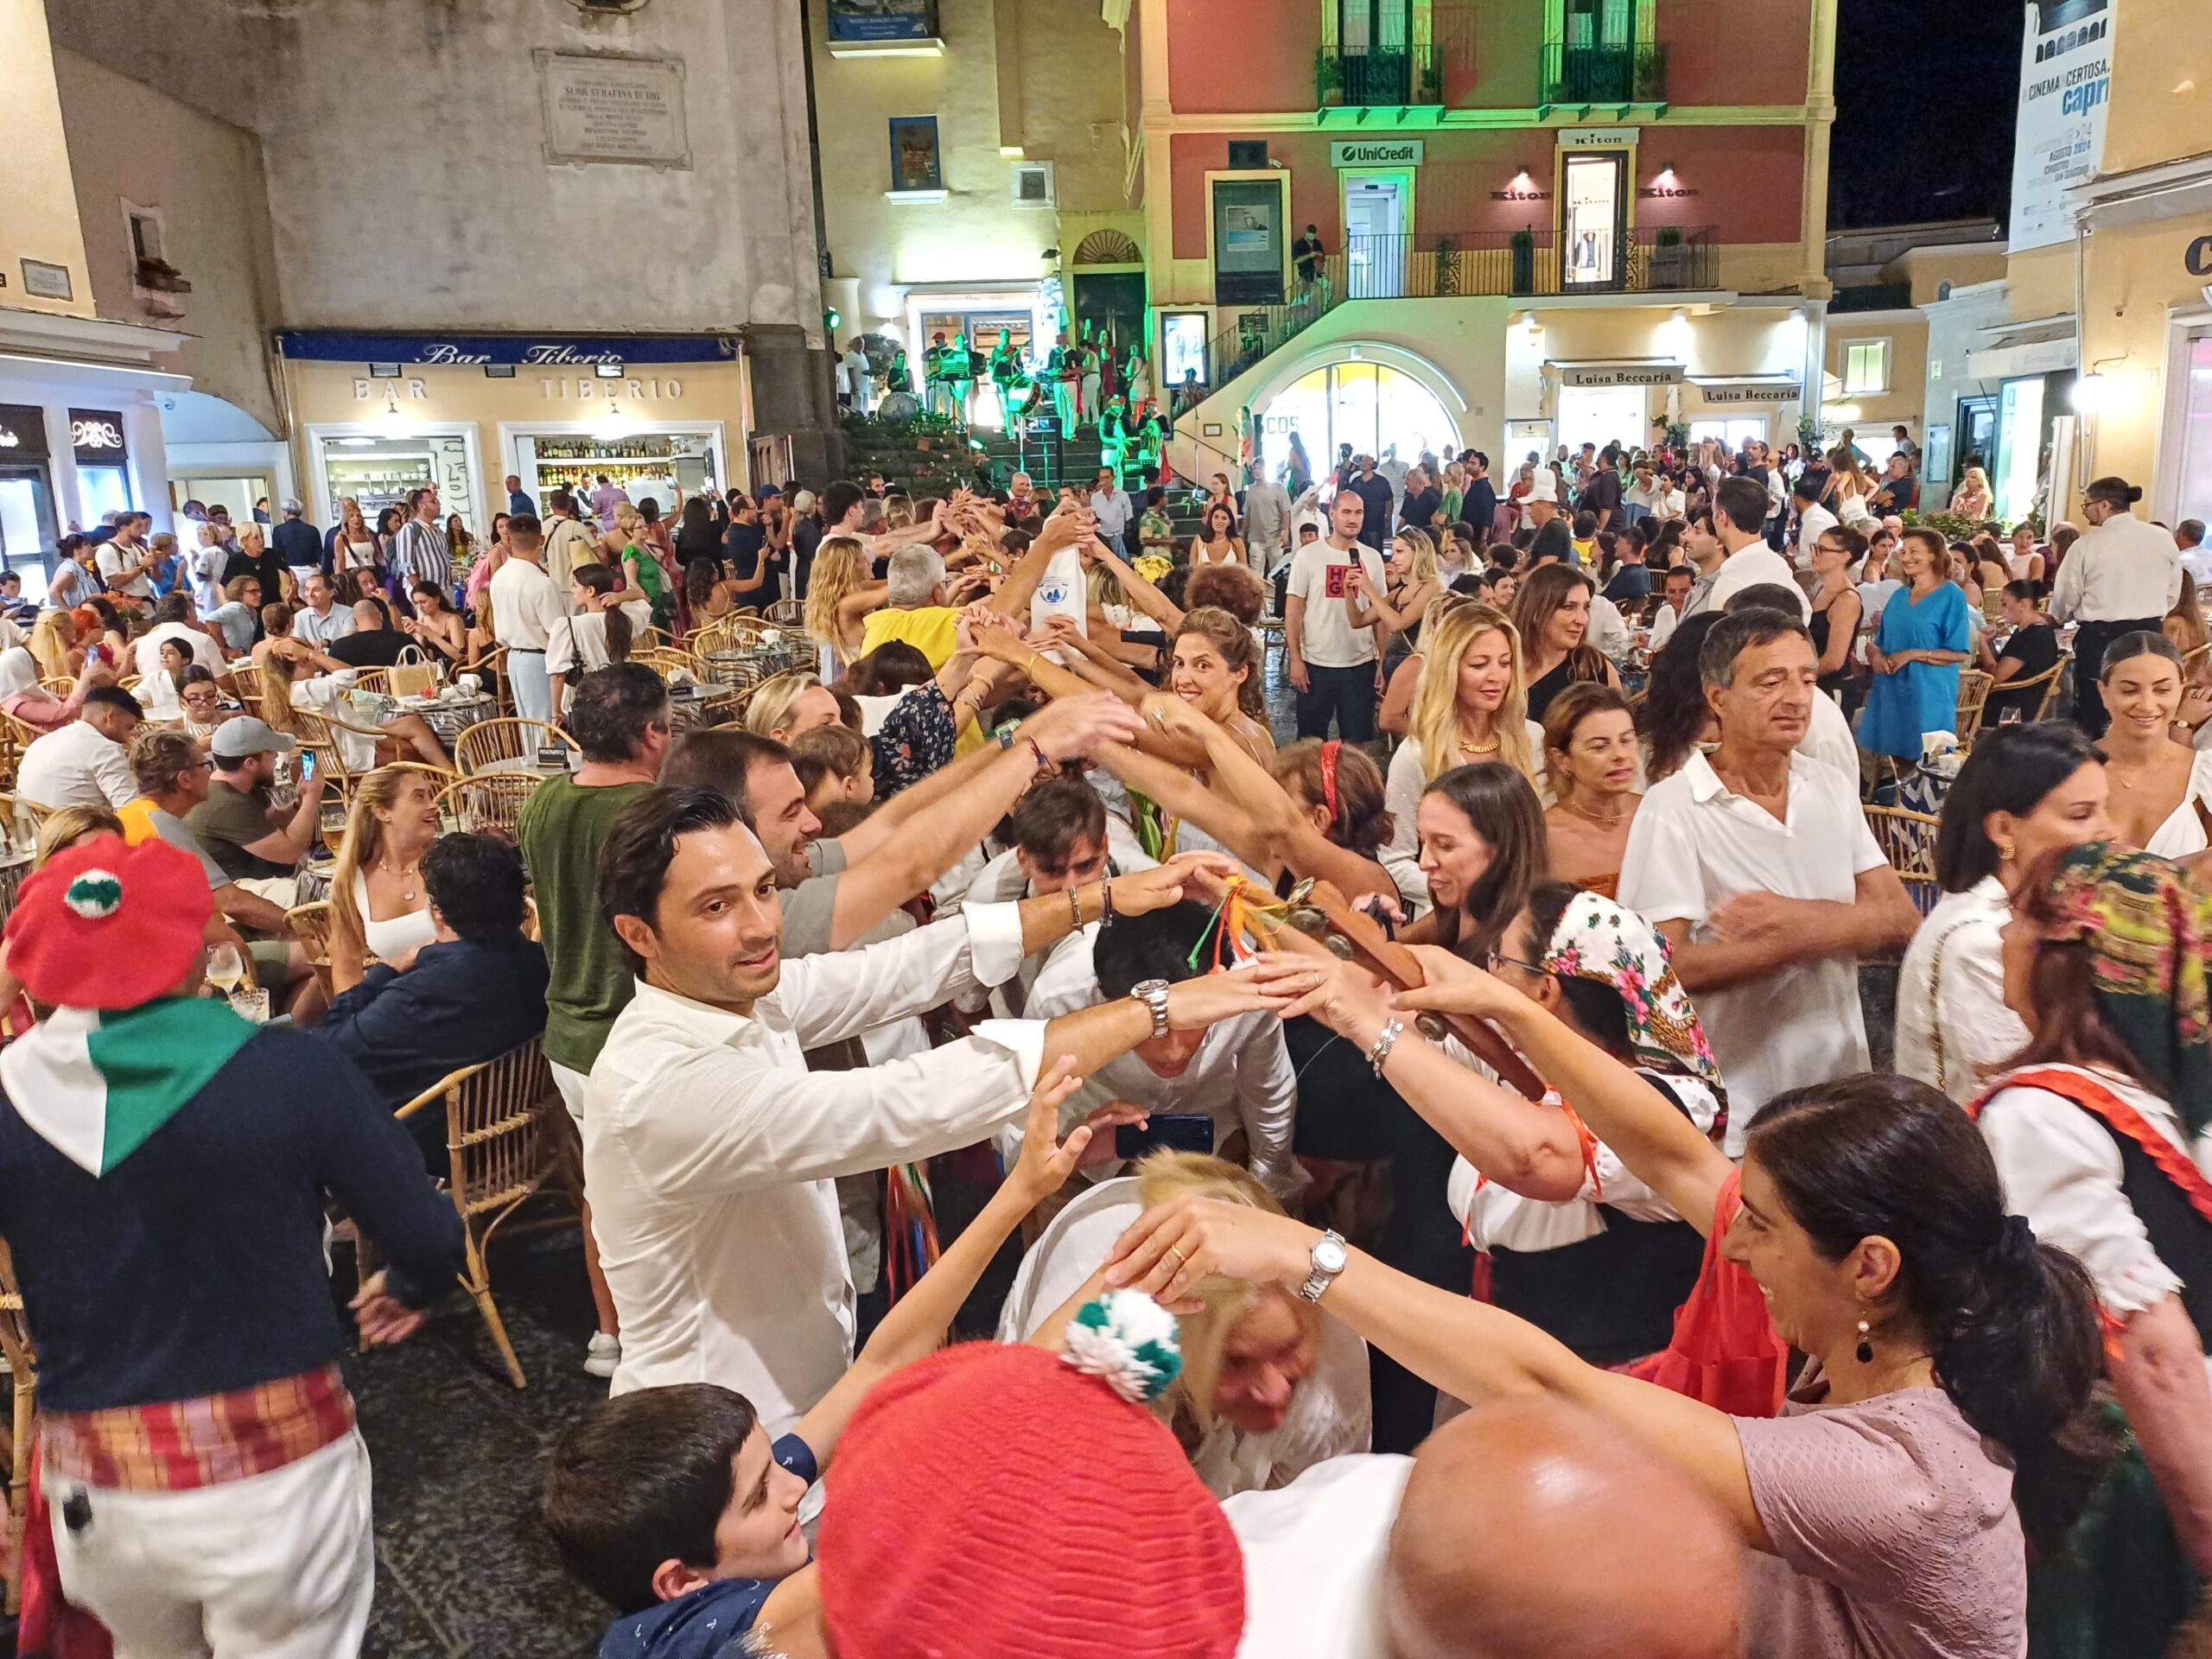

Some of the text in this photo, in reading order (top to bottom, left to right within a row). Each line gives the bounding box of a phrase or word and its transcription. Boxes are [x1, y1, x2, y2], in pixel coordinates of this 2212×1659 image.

[2029, 76, 2059, 100] CINEMA
[1575, 133, 1623, 145] Kiton
[1357, 145, 1414, 162] UniCredit
[415, 344, 624, 365] Bar Tiberio
[1576, 372, 1672, 385] Luisa Beccaria
[353, 377, 683, 401] BAR TIBERIO
[1707, 389, 1798, 401] Luisa Beccaria
